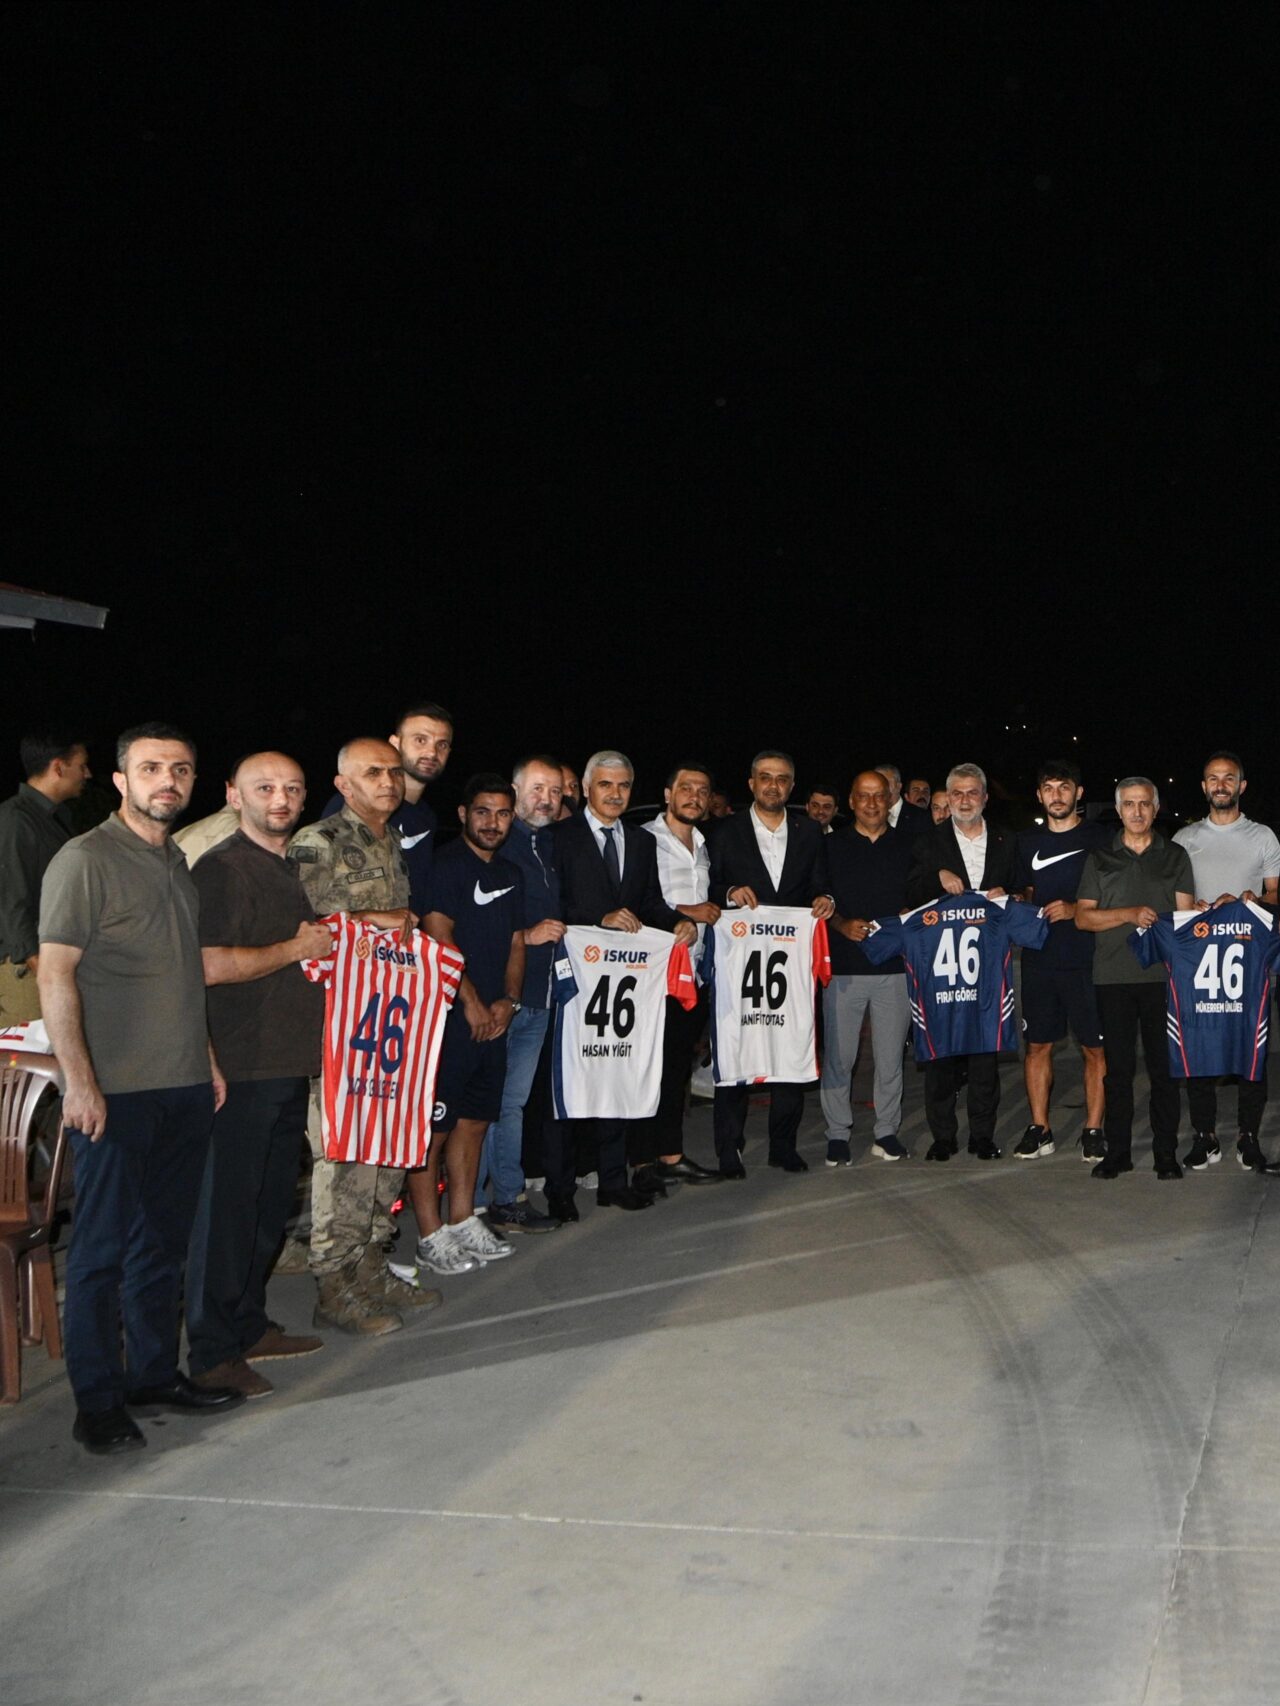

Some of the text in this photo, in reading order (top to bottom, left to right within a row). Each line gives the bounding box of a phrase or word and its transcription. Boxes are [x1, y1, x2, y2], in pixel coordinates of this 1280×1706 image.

[741, 950, 788, 1010] 46
[933, 926, 980, 986] 46
[1194, 943, 1244, 1000] 46
[350, 993, 409, 1074] 46
[585, 975, 637, 1038] 46
[582, 1041, 632, 1057] HASAN YİĞİT
